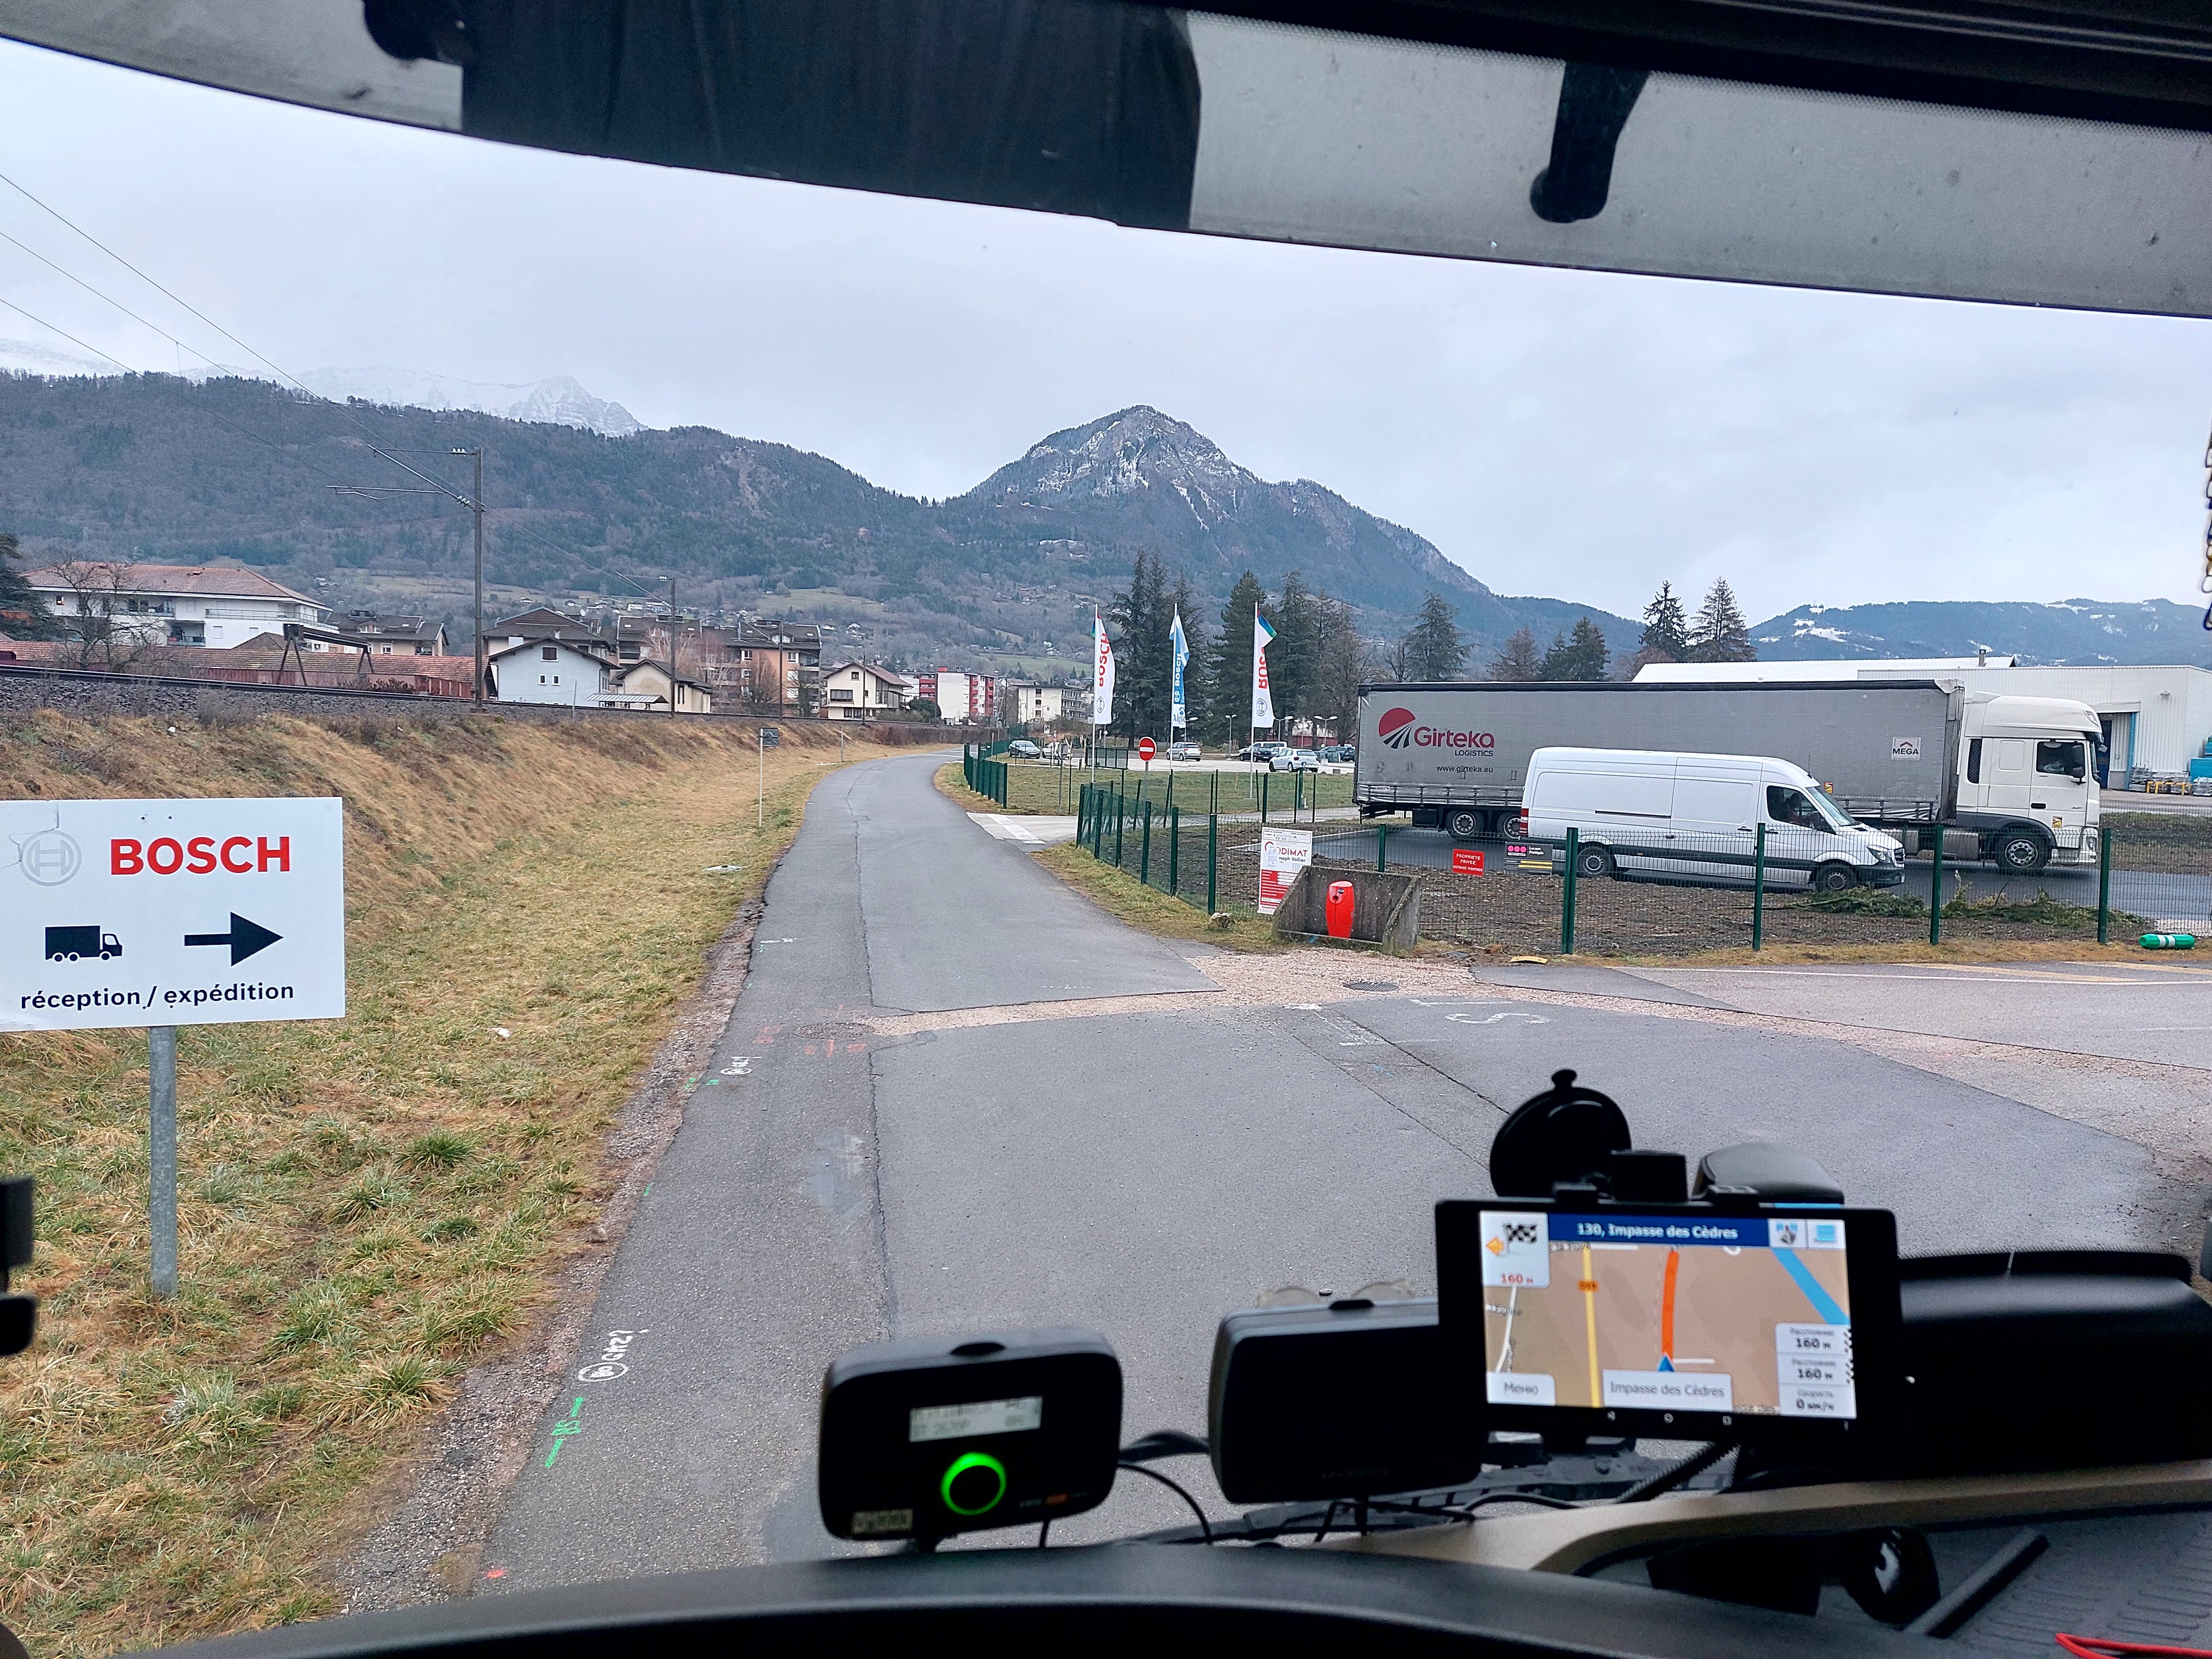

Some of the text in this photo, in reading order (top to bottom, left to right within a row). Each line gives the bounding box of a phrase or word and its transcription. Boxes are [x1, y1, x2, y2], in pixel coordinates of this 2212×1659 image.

[1099, 633, 1110, 687] BOSCH
[1414, 726, 1494, 748] Girteka
[111, 836, 290, 875] BOSCH
[21, 983, 294, 1011] réception / expédition
[1577, 1222, 1605, 1238] 130,
[1607, 1223, 1664, 1239] Impasse
[1666, 1225, 1691, 1239] des
[1610, 1381, 1658, 1396] Impasse
[1661, 1382, 1681, 1396] des
[1796, 1398, 1804, 1409] 0
